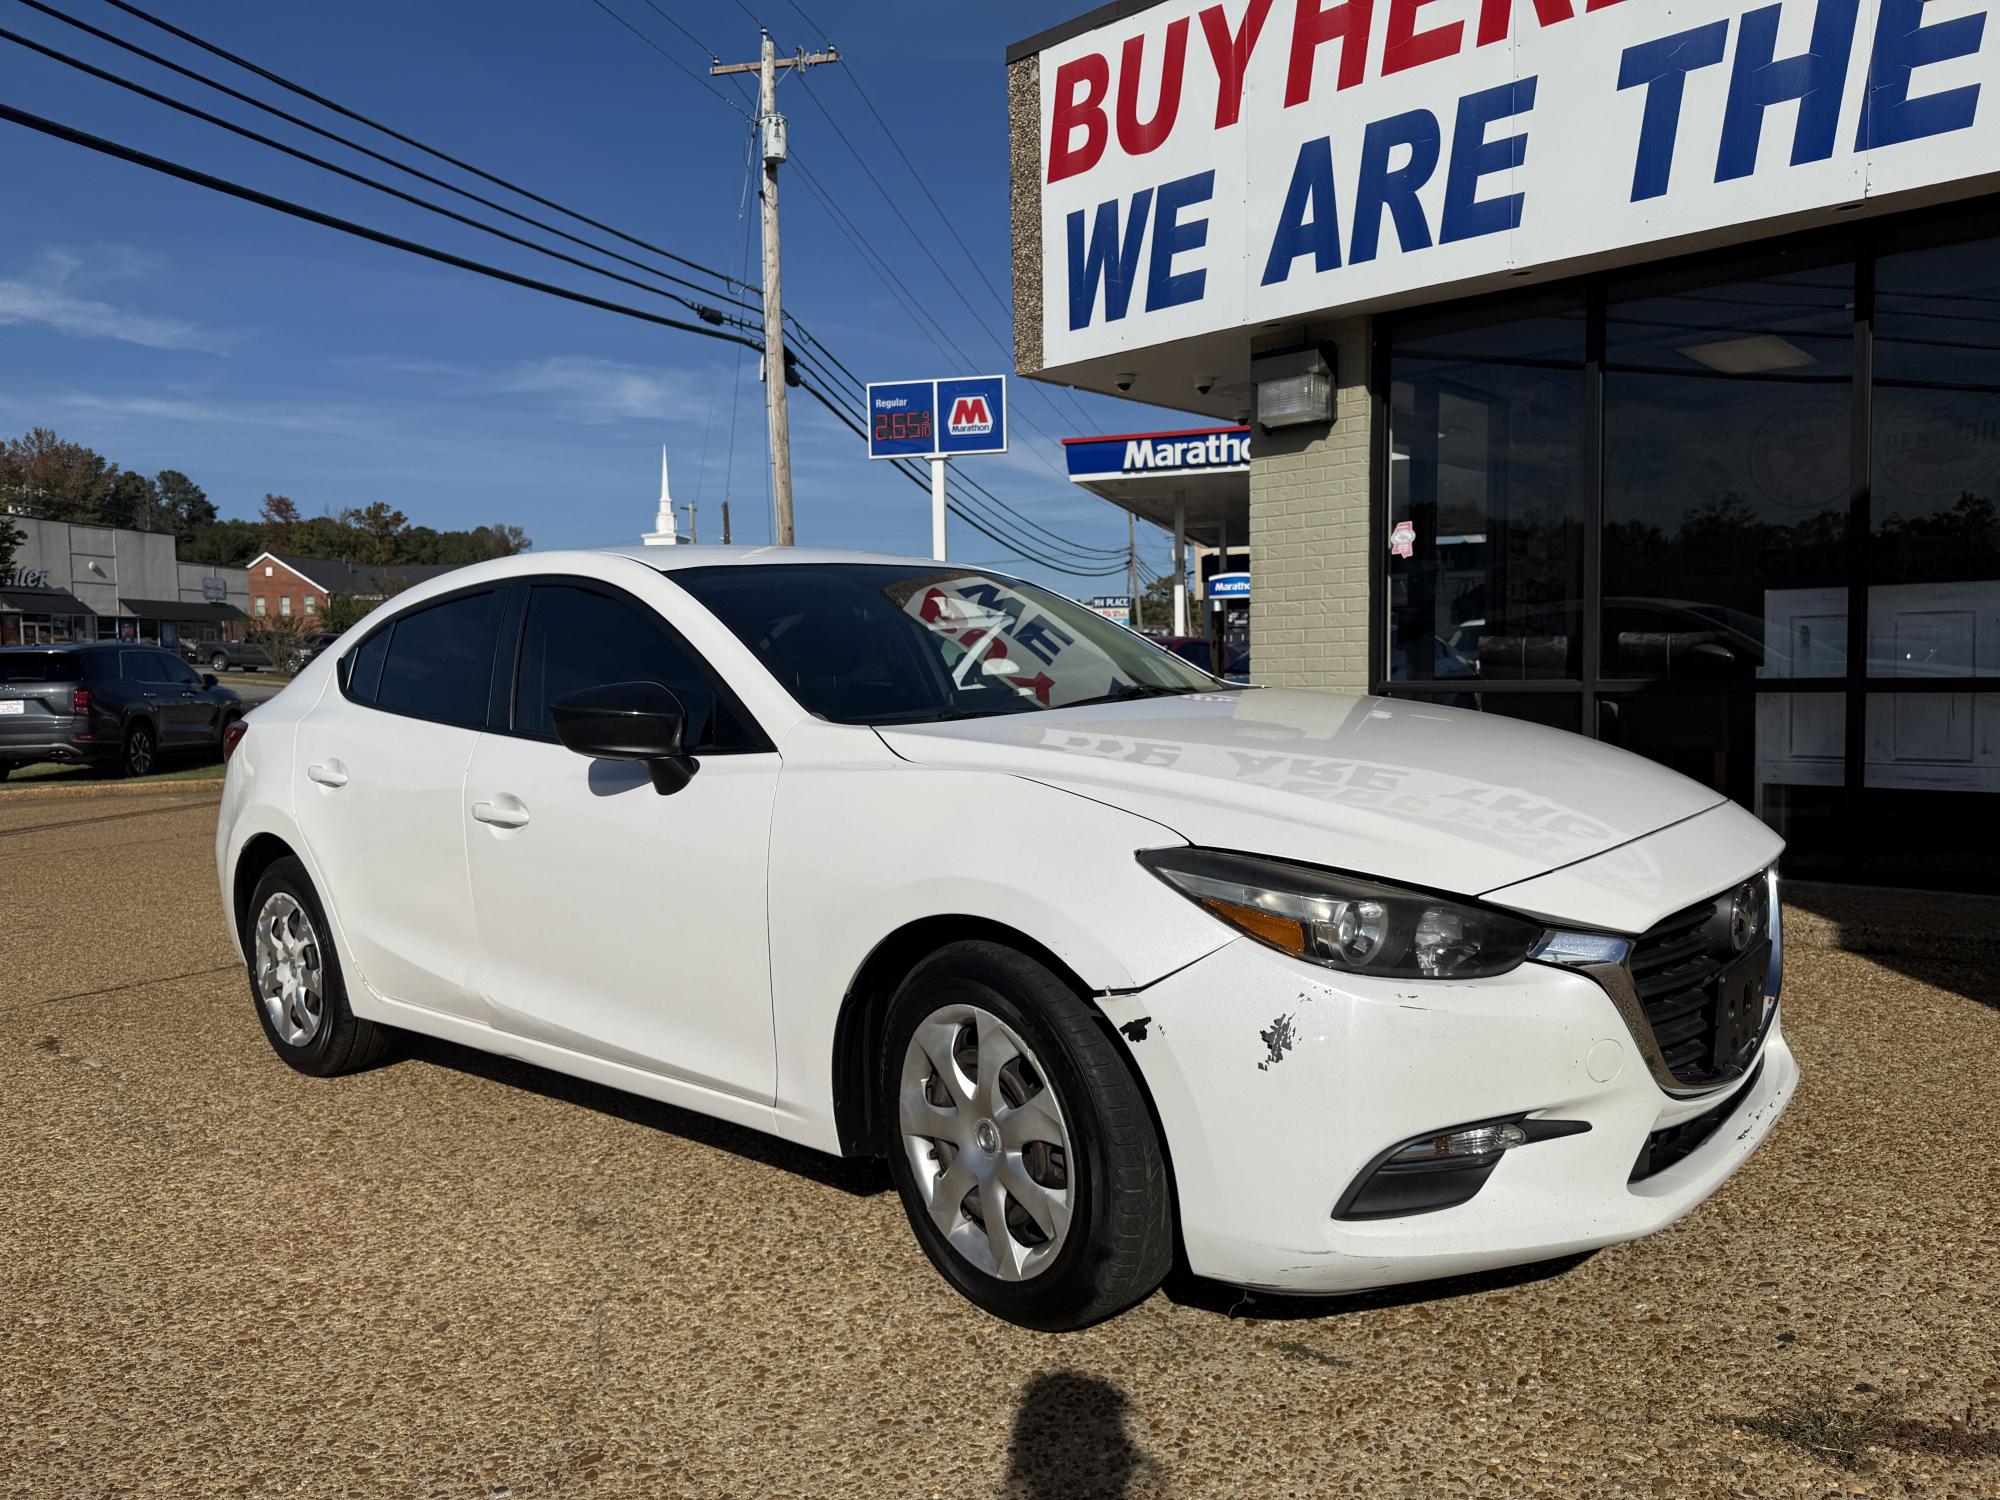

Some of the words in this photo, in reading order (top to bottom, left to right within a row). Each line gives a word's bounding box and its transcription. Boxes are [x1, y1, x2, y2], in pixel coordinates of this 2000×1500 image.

[1067, 169, 1216, 331] WE
[1260, 75, 1538, 287] ARE
[1617, 0, 1987, 203] THE
[876, 398, 908, 409] Regular
[875, 412, 920, 441] 2.65
[952, 424, 990, 433] Marathon
[1123, 433, 1250, 470] Marath
[1215, 582, 1250, 592] Marath
